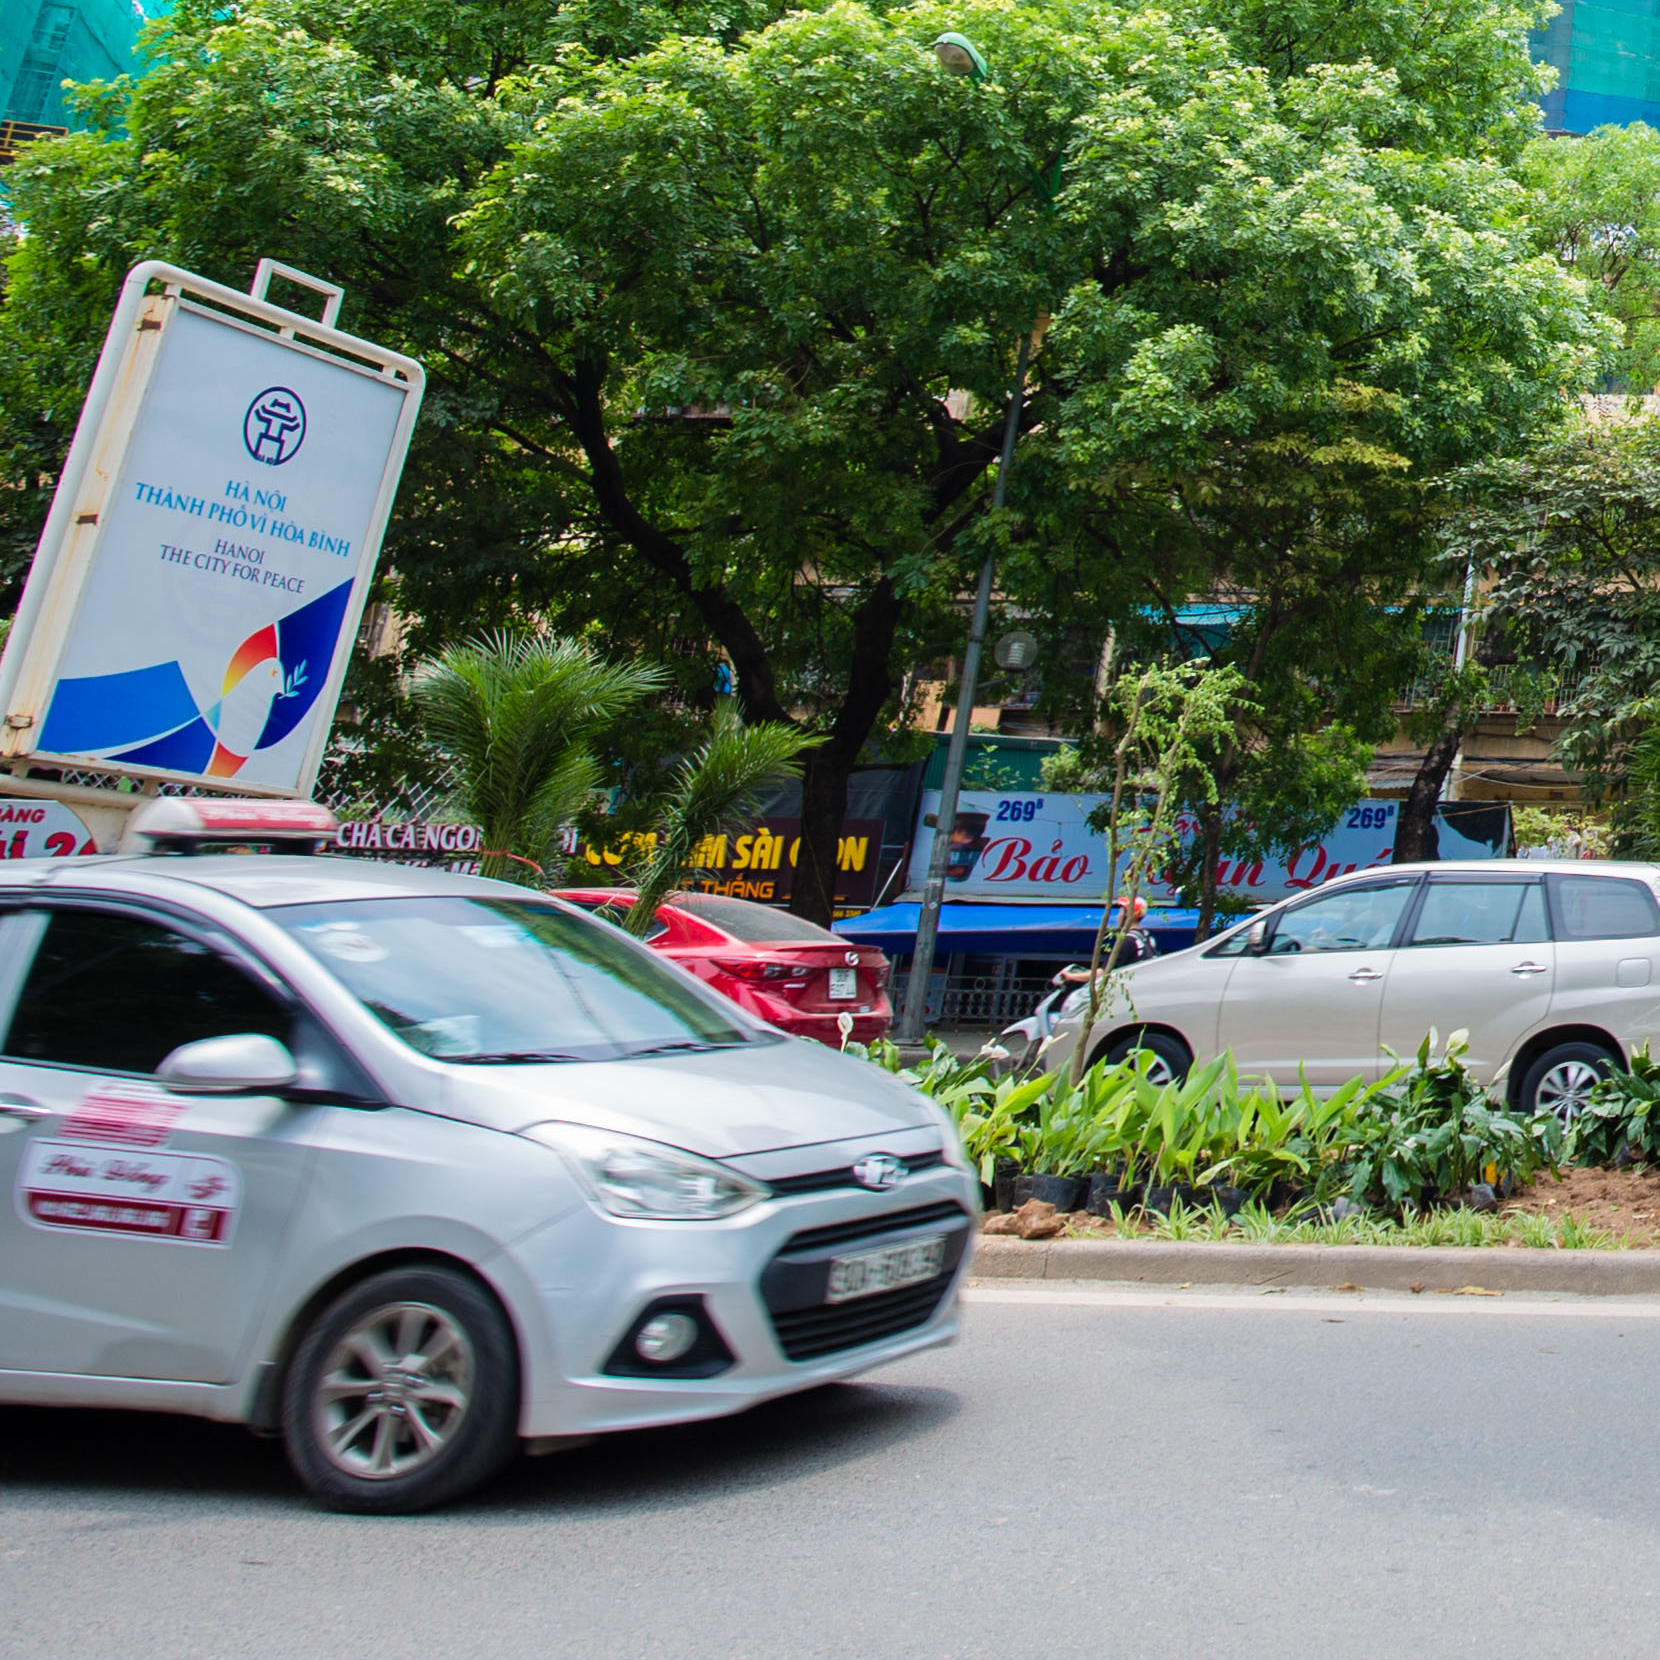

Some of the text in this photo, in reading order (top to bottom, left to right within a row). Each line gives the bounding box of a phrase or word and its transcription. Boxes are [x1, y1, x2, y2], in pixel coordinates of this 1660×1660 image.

[135, 481, 351, 557] THÀNH PHỐ VÌ HÒA BÌNH
[225, 480, 287, 512] HÀ NỘI
[160, 544, 305, 594] THE CITY FOR PEACE
[214, 539, 265, 565] HANOI
[732, 826, 785, 870] SÀI
[982, 836, 1093, 884] Bảo
